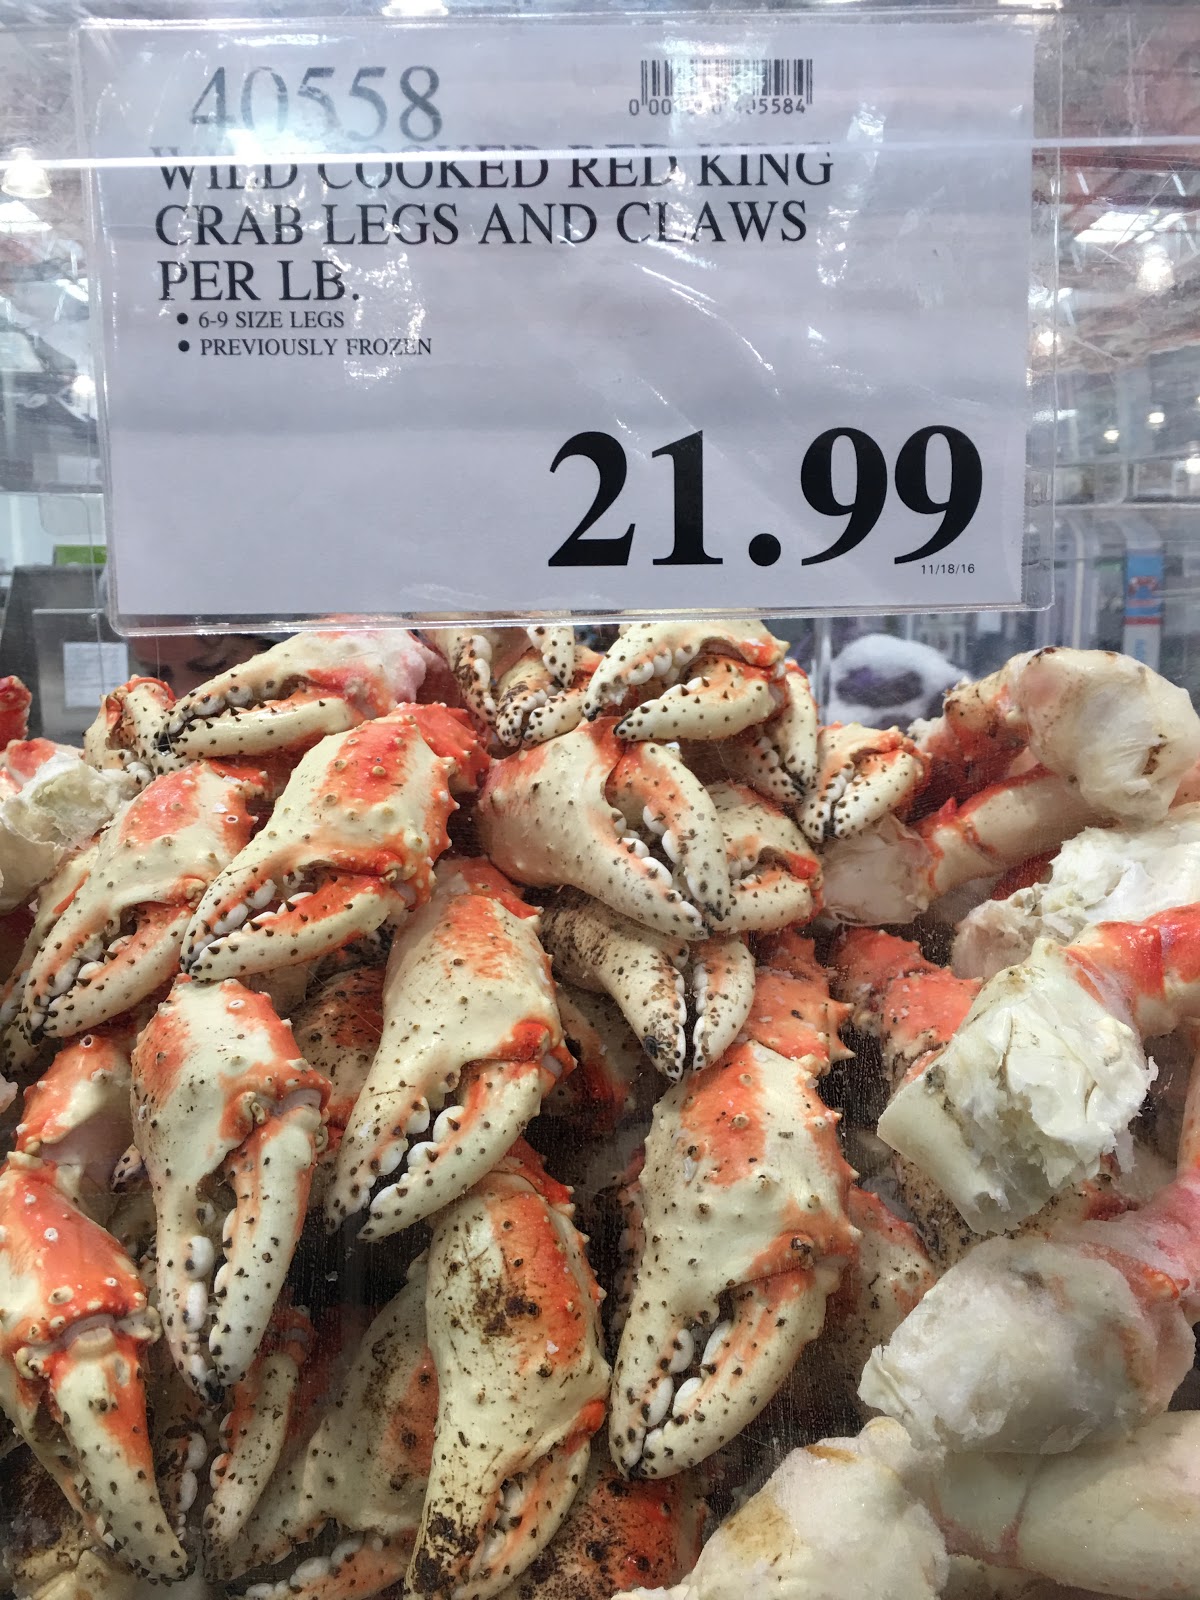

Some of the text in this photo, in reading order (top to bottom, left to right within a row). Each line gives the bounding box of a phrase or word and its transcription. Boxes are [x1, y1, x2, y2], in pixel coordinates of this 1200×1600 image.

[189, 65, 443, 143] 40558
[150, 141, 834, 190] WILD COOKED RED KING
[155, 199, 807, 246] CRAB LEGS AND CLAWS
[157, 259, 360, 301] PER LB.
[198, 310, 345, 329] 6-9 SIZE LEGS
[200, 337, 432, 356] PREVIOUSLY FROZEN
[547, 424, 983, 567] 21.99
[920, 562, 976, 575] 11/18/16
